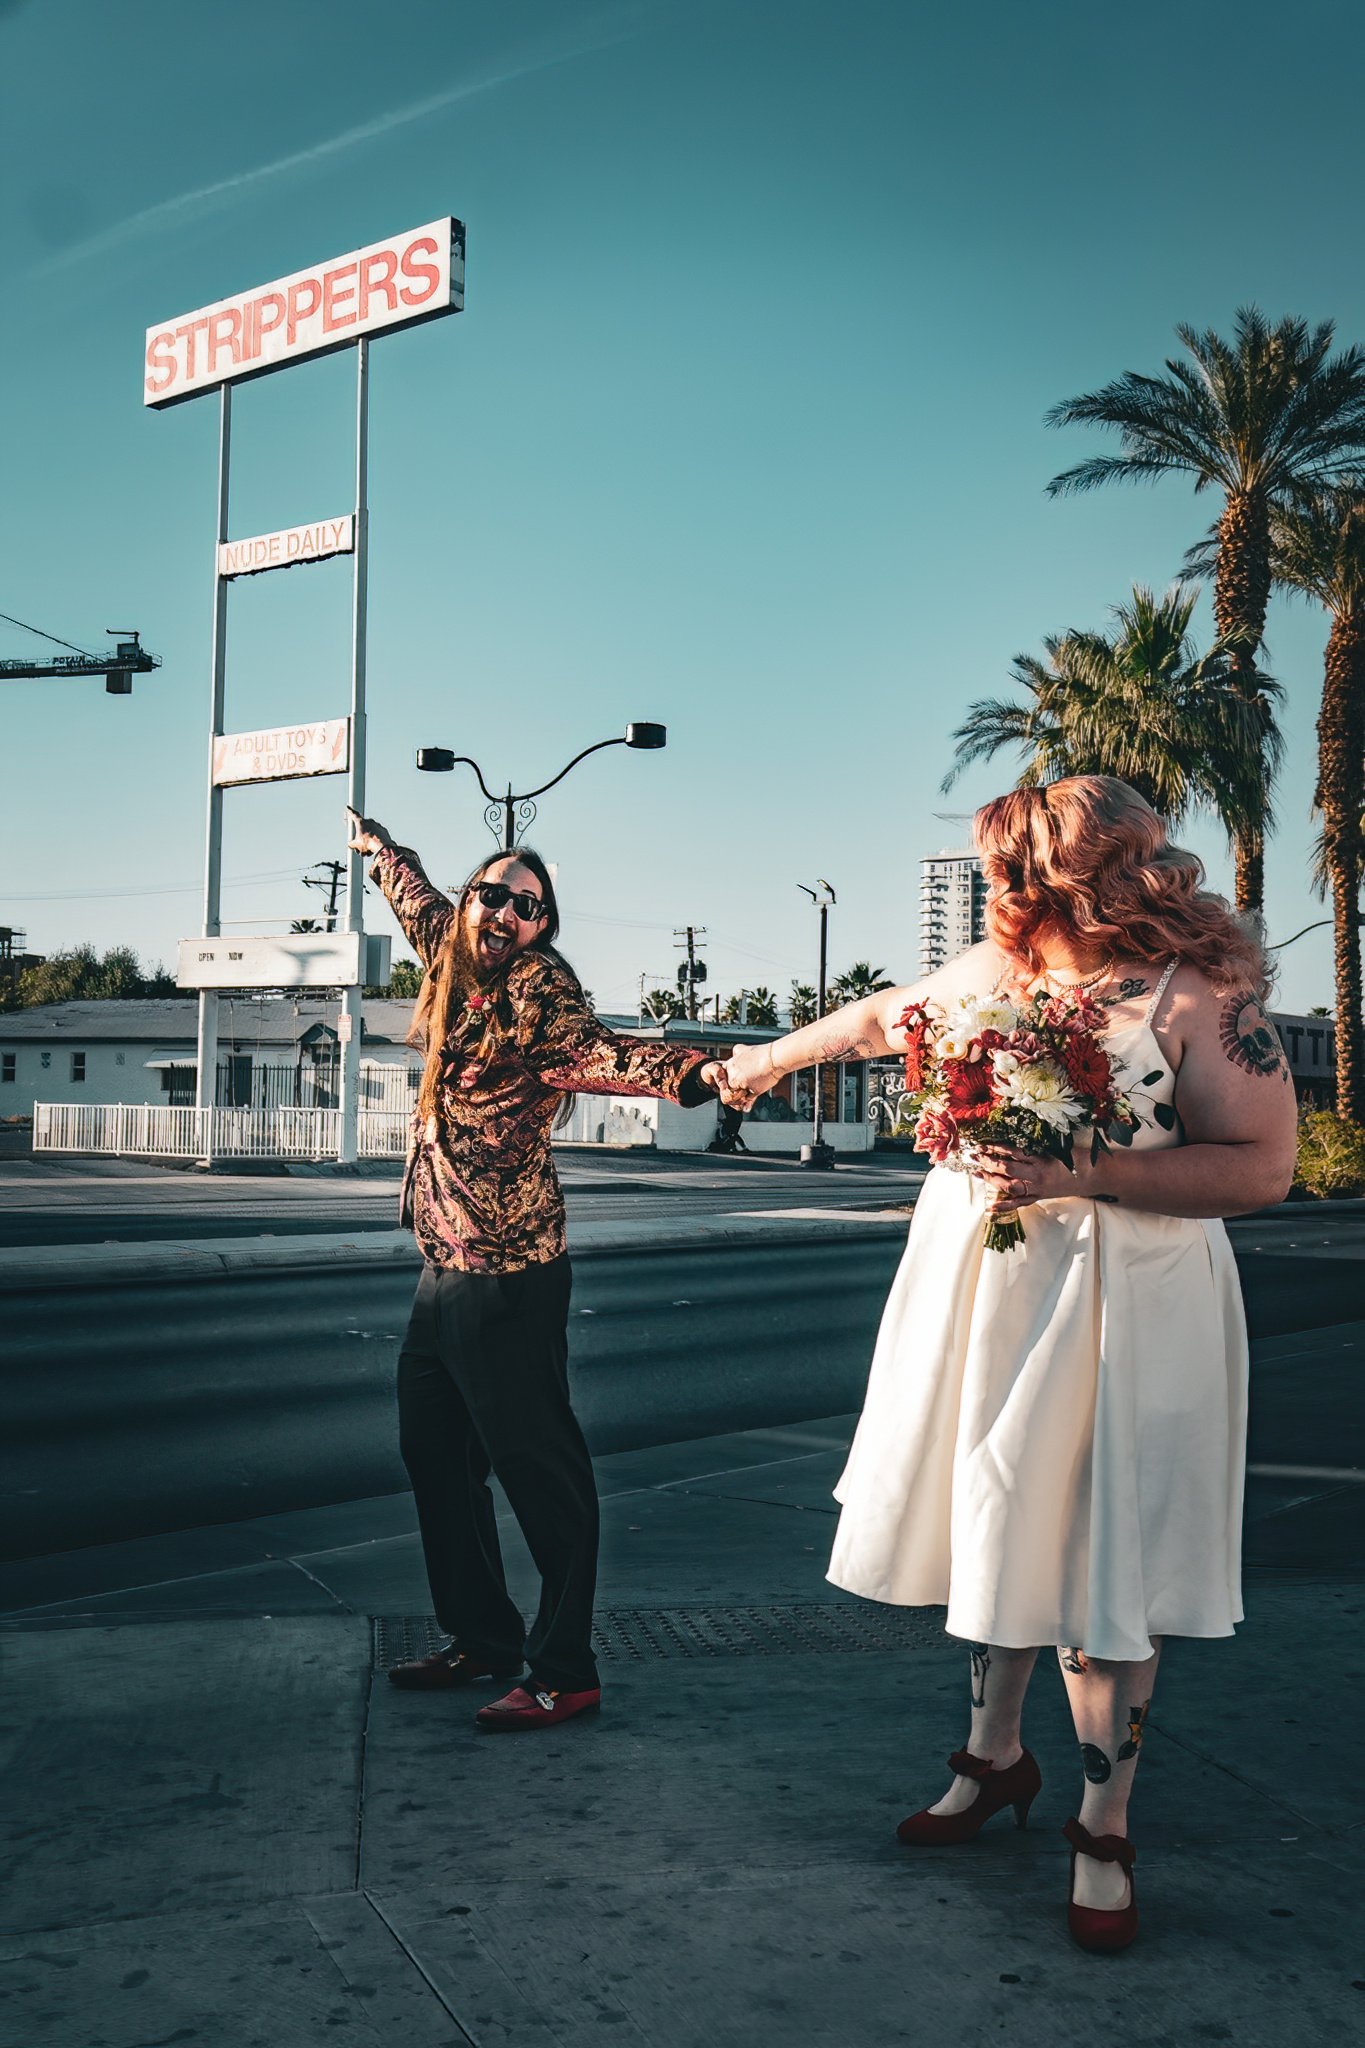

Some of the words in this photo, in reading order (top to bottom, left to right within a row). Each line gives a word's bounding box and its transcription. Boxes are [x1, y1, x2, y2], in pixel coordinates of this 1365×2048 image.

[145, 237, 440, 393] STRIPPERS
[226, 536, 280, 571] NUDE
[287, 521, 345, 557] DAILY
[233, 733, 281, 756] ADULT
[198, 952, 215, 962] OPEN
[228, 952, 243, 961] NOW
